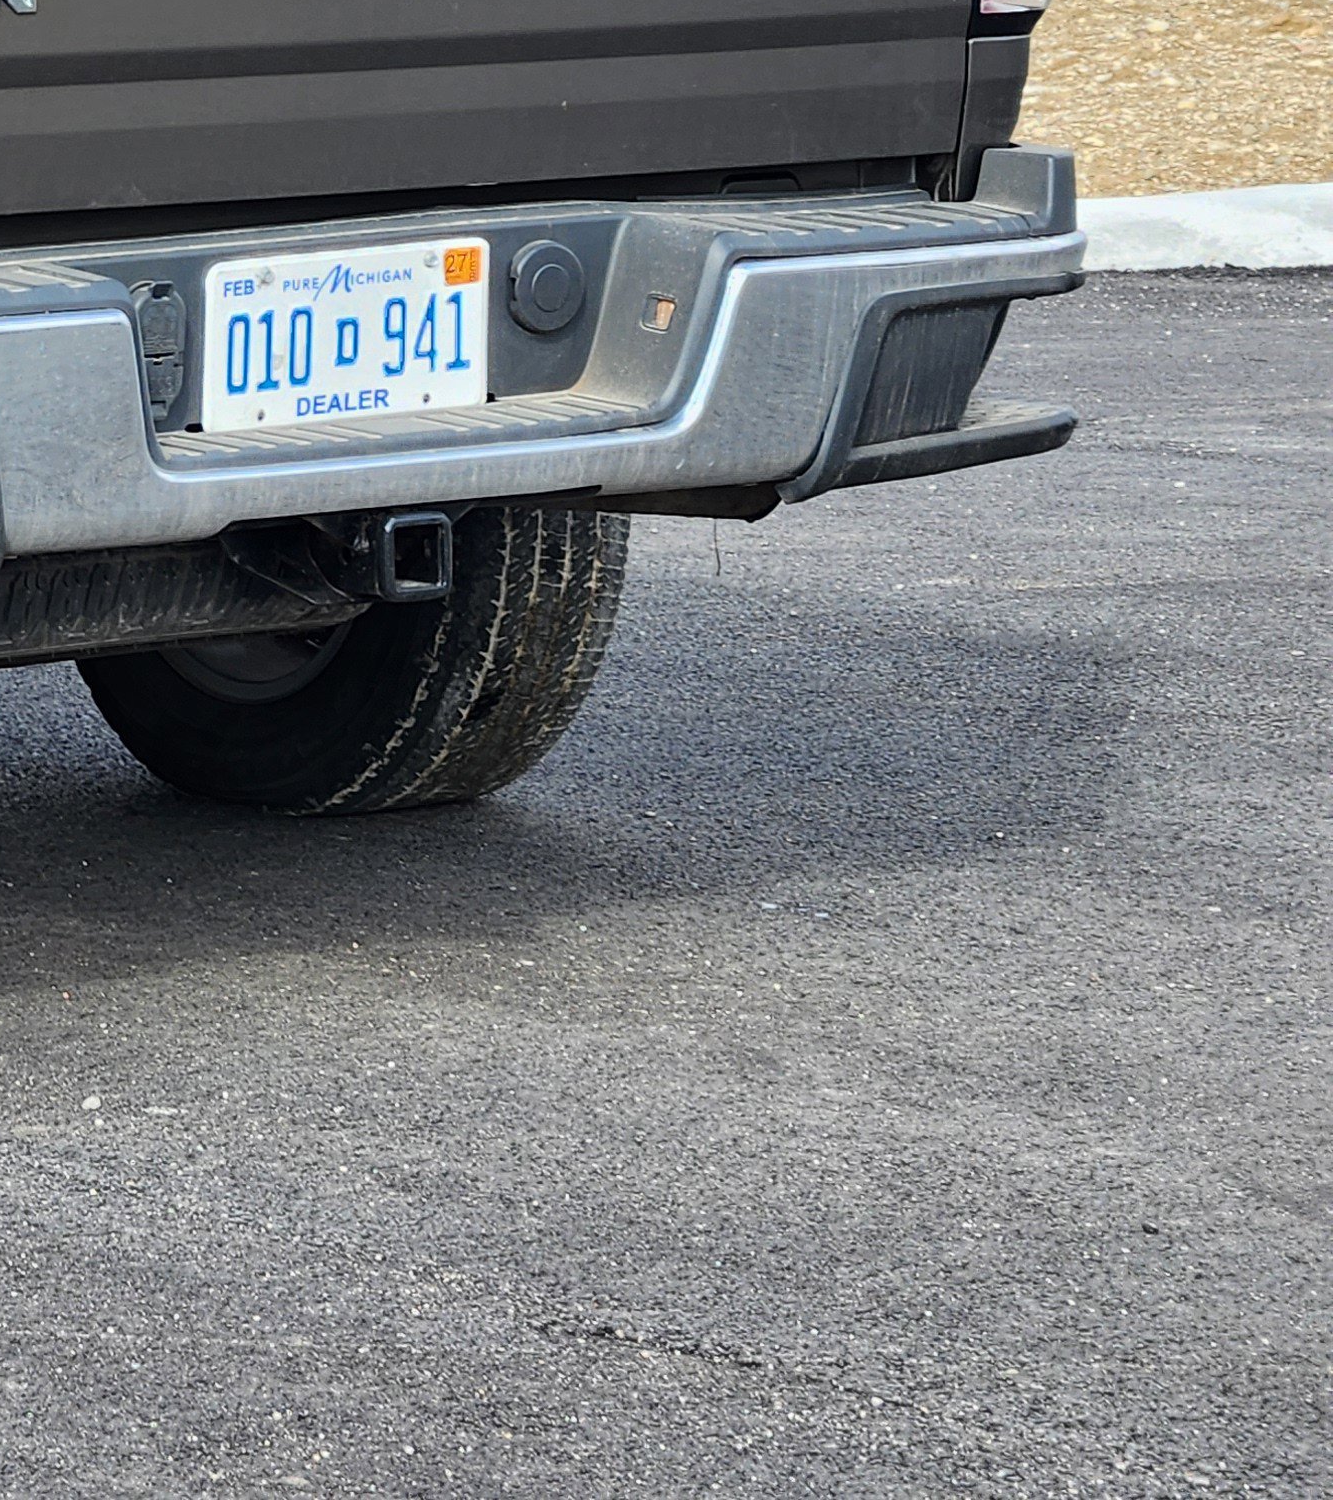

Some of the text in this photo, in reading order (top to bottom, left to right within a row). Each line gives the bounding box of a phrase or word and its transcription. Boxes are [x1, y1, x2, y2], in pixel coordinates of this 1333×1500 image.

[444, 252, 468, 273] 27
[224, 278, 255, 298] FEB
[283, 264, 413, 300] PURE MICHIGAN
[227, 291, 471, 395] 010 D 941
[296, 389, 390, 417] DEALER
